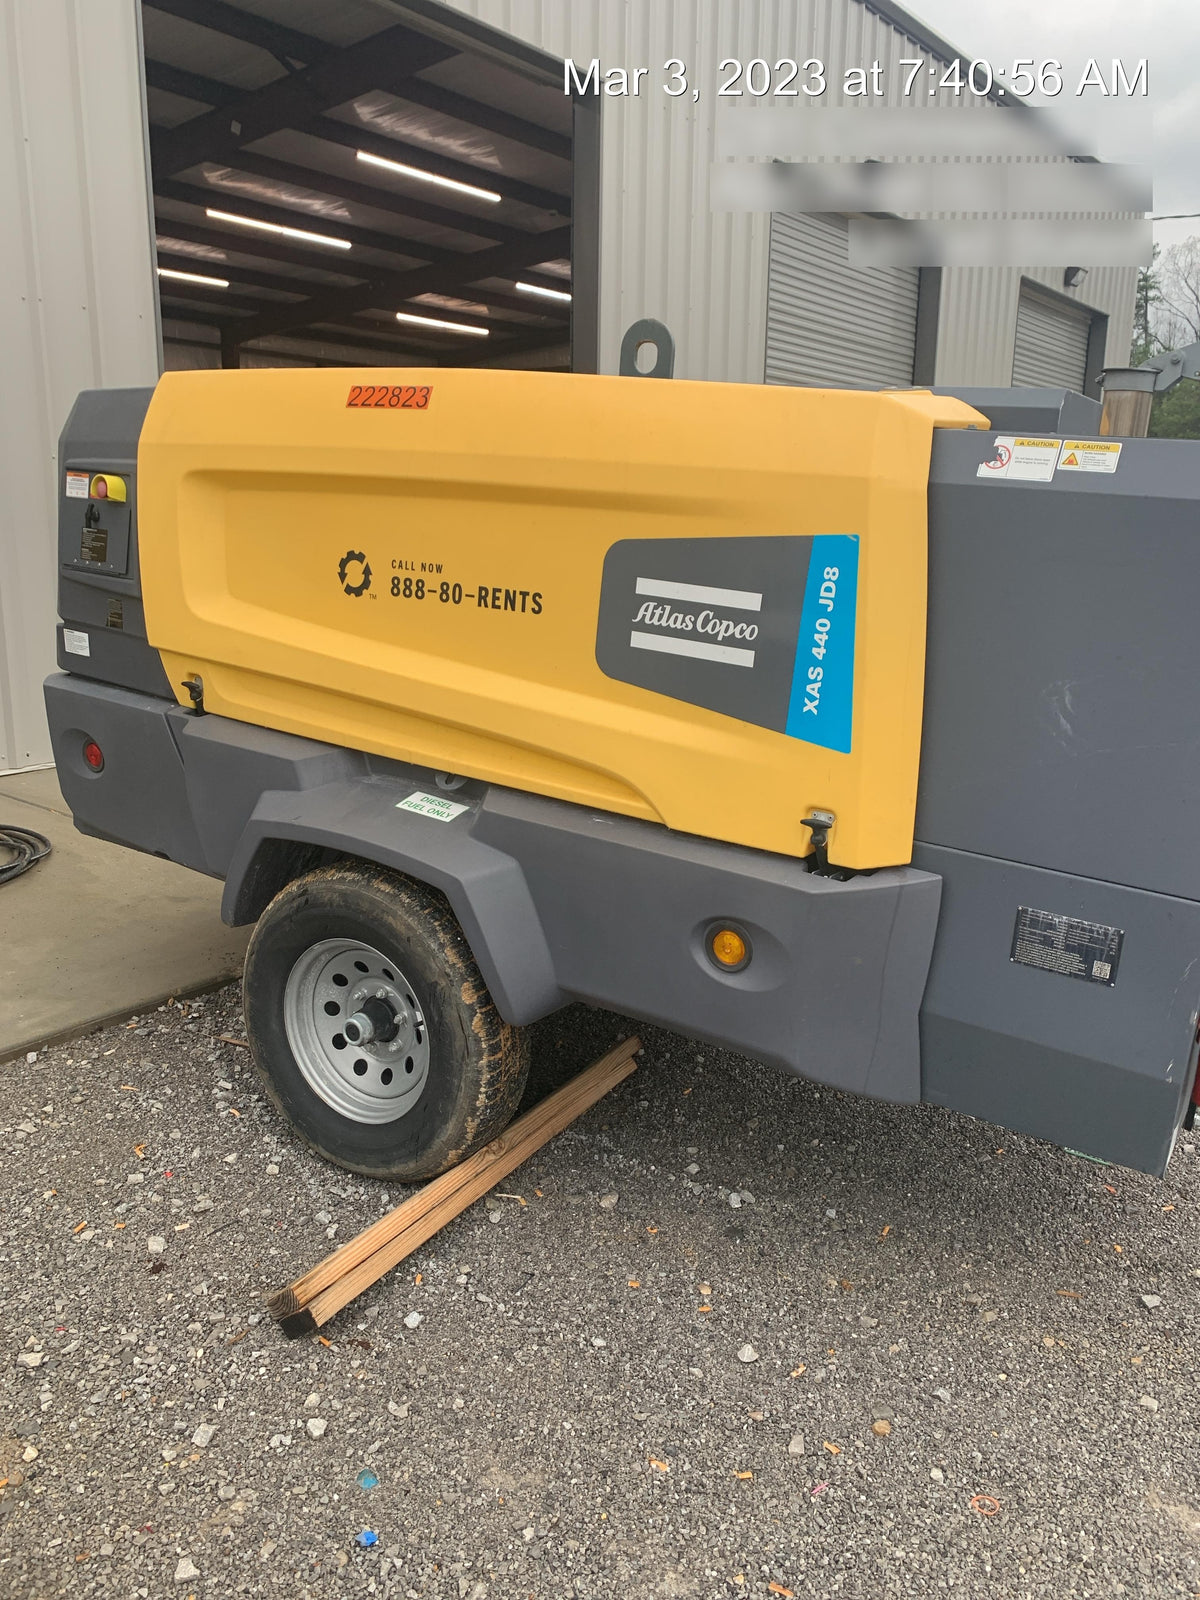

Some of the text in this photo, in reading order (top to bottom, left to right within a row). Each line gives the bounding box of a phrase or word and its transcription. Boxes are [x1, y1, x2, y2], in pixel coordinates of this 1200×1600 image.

[347, 386, 430, 408] 222823
[391, 559, 444, 574] CALL NOW
[390, 576, 543, 615] 888-80-RENTS
[632, 601, 759, 641] Atlas Copco
[803, 566, 840, 715] XAS 440 JD8
[402, 800, 454, 819] FUEL ONLY
[420, 796, 453, 810] DIESEL
